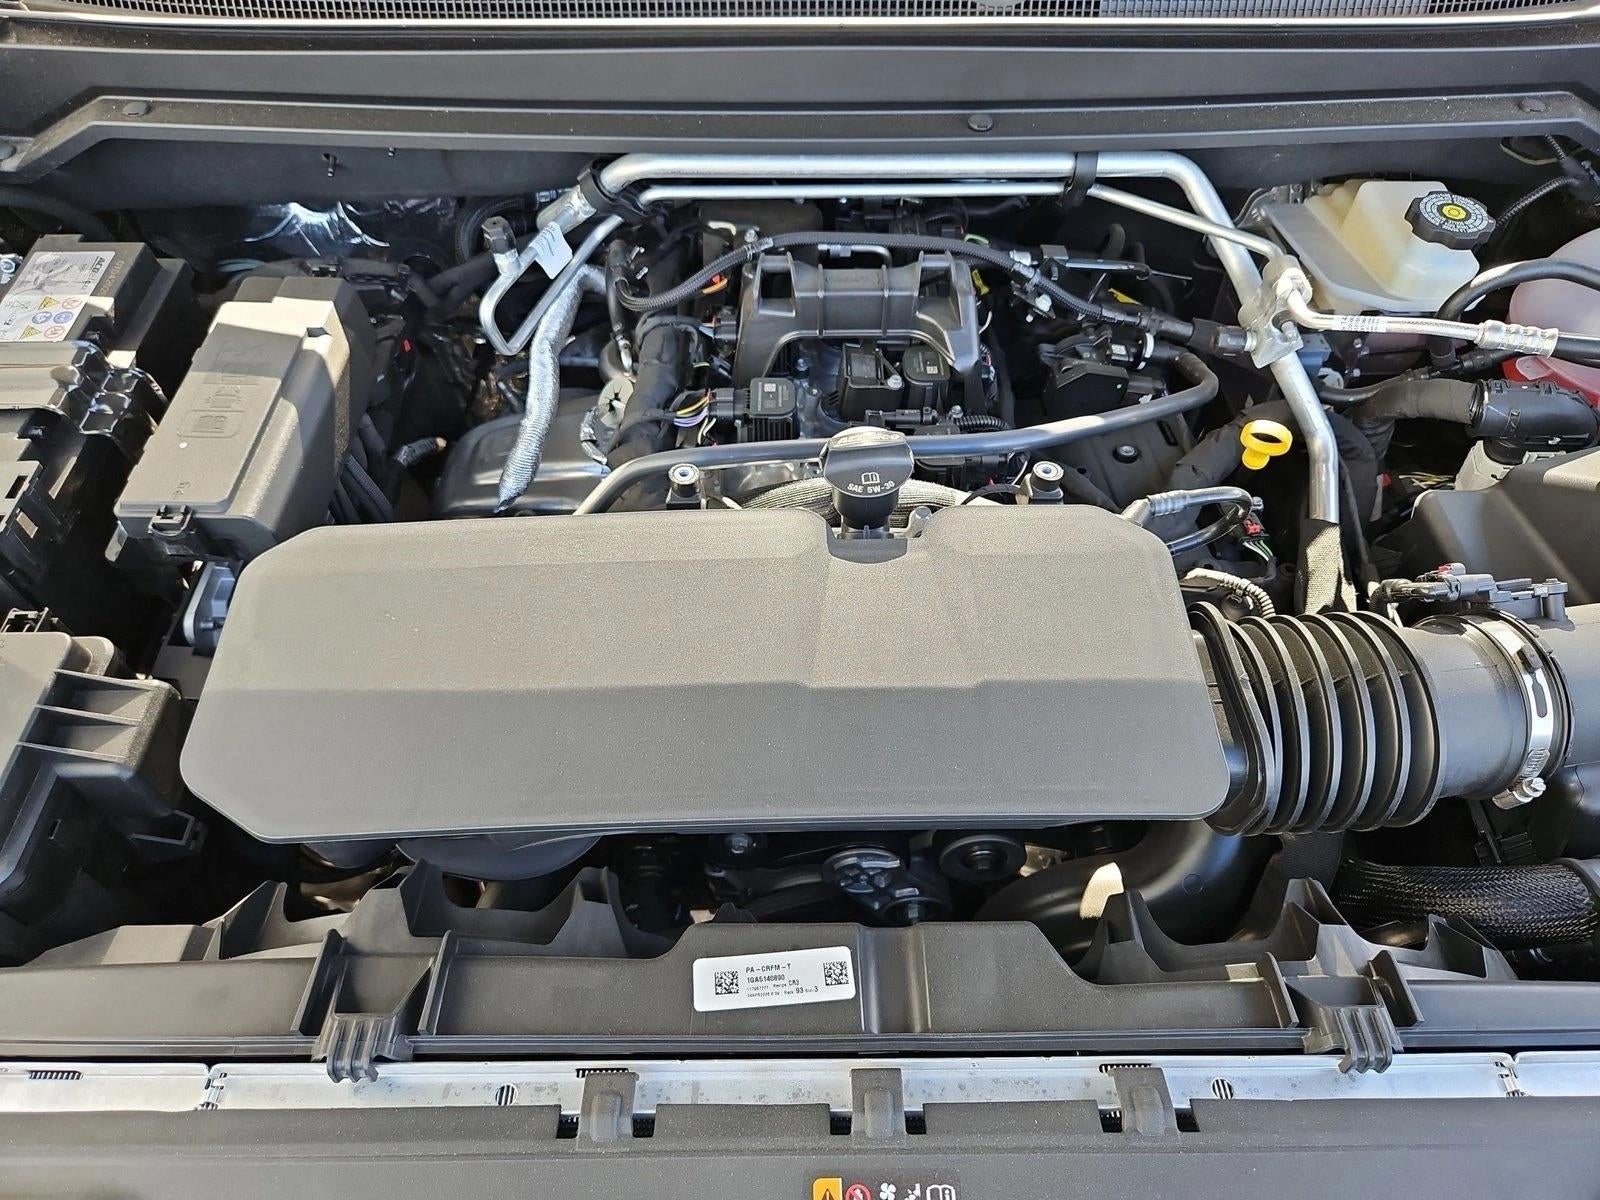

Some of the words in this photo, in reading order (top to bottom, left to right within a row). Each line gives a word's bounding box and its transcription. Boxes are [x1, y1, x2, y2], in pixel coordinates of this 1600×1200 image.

[847, 482, 864, 493] SAE
[867, 480, 895, 493] 5W-30
[795, 986, 804, 994] 93
